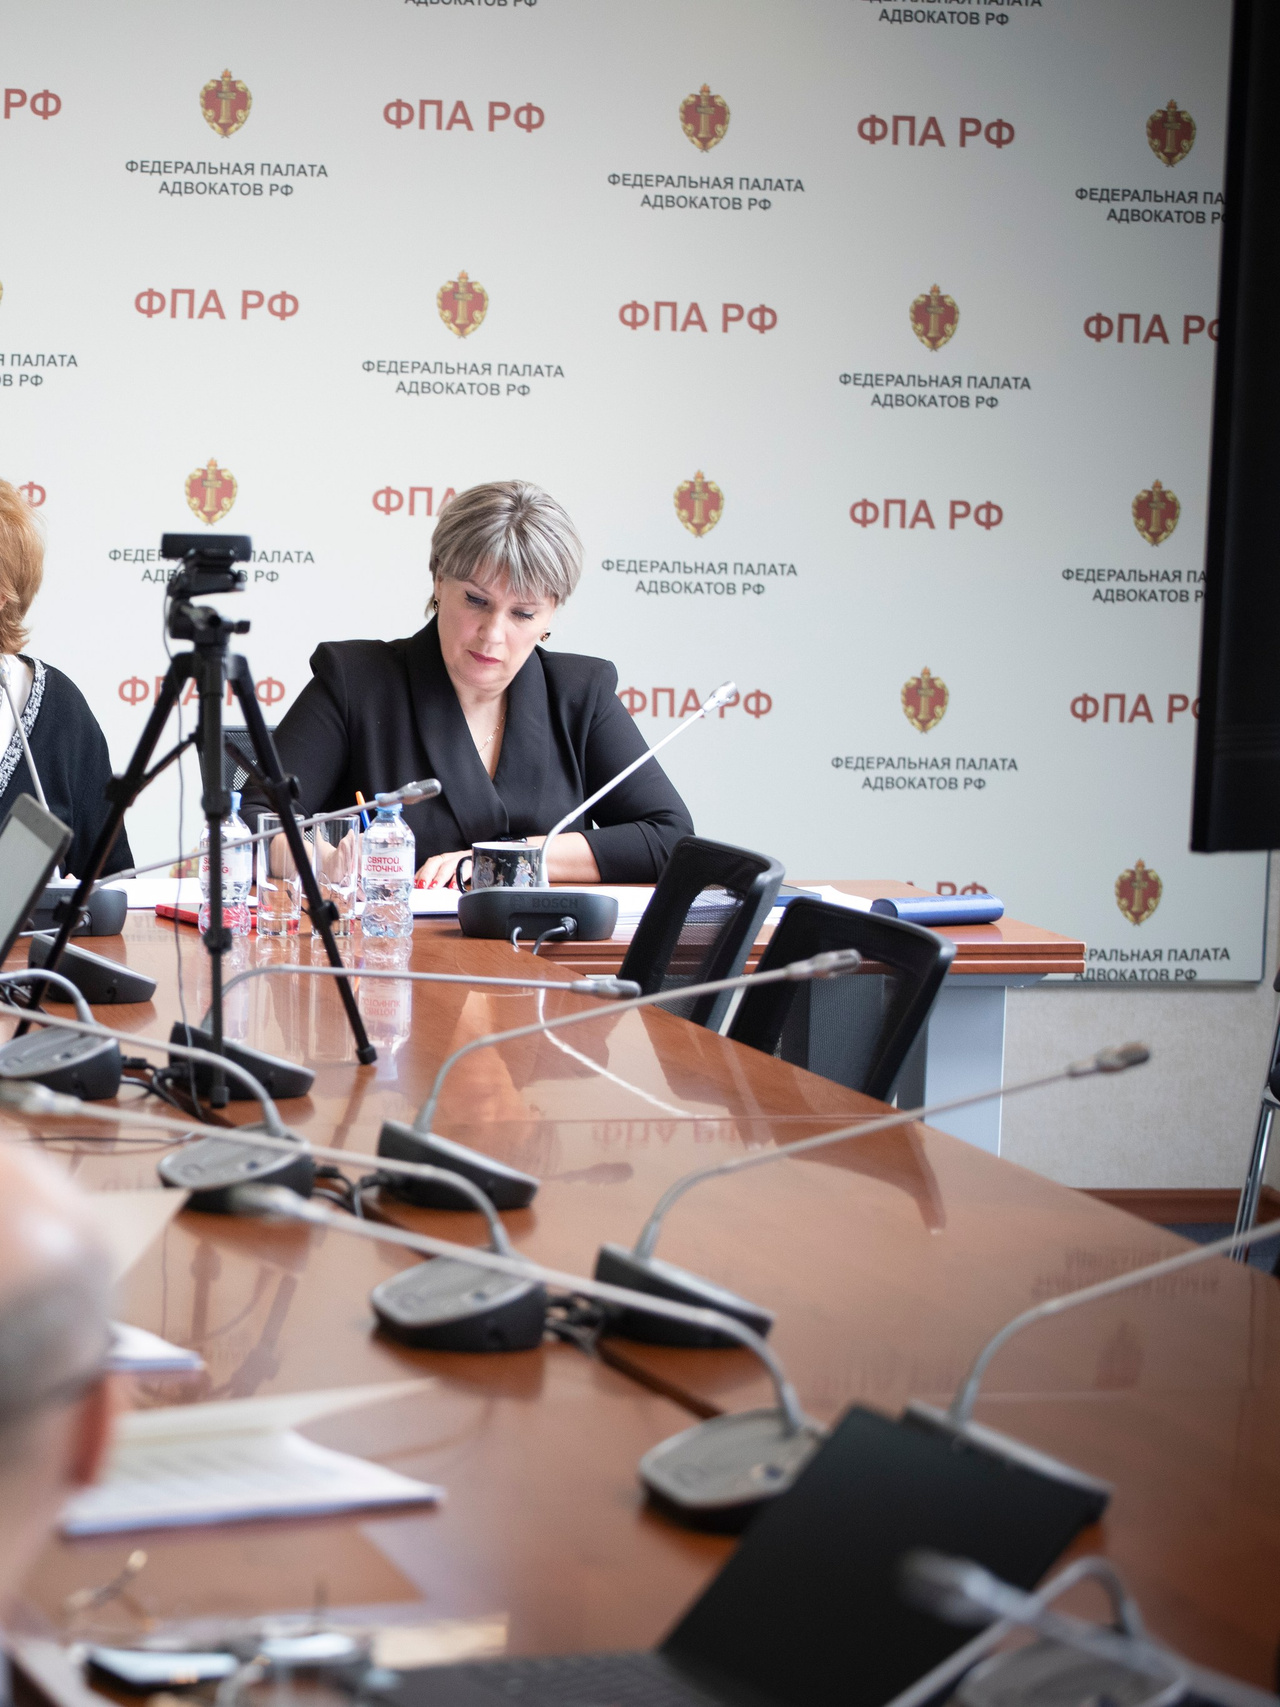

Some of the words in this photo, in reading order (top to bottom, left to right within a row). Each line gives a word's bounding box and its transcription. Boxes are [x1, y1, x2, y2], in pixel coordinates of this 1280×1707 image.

[878, 9, 980, 25] АДВОКАТОВ
[985, 12, 1010, 26] РФ
[3, 87, 62, 121] РФ
[382, 98, 474, 132] ФПА
[488, 101, 545, 134] РФ
[857, 114, 946, 148] ФПА
[959, 117, 1016, 150] РФ
[125, 159, 255, 176] ФЕДЕРАЛЬНАЯ
[260, 162, 329, 178] ПАЛАТА
[158, 180, 264, 197] АДВОКАТОВ
[269, 183, 294, 197] РФ
[607, 173, 734, 190] ФЕДЕРАЛЬНАЯ
[738, 176, 806, 193] ПАЛАТА
[640, 194, 743, 211] АДВОКАТОВ
[747, 197, 772, 211] РФ
[1075, 187, 1198, 204] ФЕДЕРАЛЬНАЯ
[1106, 208, 1206, 224] АДВОКАТОВ
[134, 287, 226, 320] ФПА
[241, 289, 300, 321] РФ
[618, 300, 708, 333] ФПА
[721, 302, 778, 335] РФ
[1083, 312, 1170, 345] ФПА
[10, 353, 78, 368] ПАЛАТА
[361, 359, 492, 376] ФЕДЕРАЛЬНАЯ
[497, 363, 565, 378] ПАЛАТА
[19, 373, 44, 387] РФ
[395, 380, 501, 396] АДВОКАТОВ
[506, 383, 531, 397] РФ
[838, 372, 962, 388] ФЕДЕРАЛЬНАЯ
[967, 375, 1032, 390] ПАЛАТА
[870, 393, 971, 409] АДВОКАТОВ
[975, 395, 1000, 409] РФ
[17, 481, 47, 509] Ф
[849, 498, 936, 530] ФПА
[949, 499, 1004, 531] РФ
[254, 570, 280, 583] РФ
[601, 559, 729, 575] ФЕДЕРАЛЬНАЯ
[733, 562, 798, 577] ПАЛАТА
[1061, 568, 1182, 584] ФЕДЕРАЛЬНАЯ
[635, 580, 737, 596] АДВОКАТОВ
[741, 582, 766, 596] РФ
[1092, 588, 1190, 604] АДВОКАТОВ
[618, 686, 704, 719] ФПА
[1070, 693, 1154, 724] ФПА
[831, 756, 951, 772] ФЕДЕРАЛЬНАЯ
[955, 757, 1019, 772] ПАЛАТА
[861, 776, 959, 792] АДВОКАТОВ
[963, 776, 987, 791] РФ
[531, 897, 579, 909] BOSCH
[1085, 949, 1162, 962] РАЛЬНАЯ
[1168, 947, 1231, 962] ПАЛАТА
